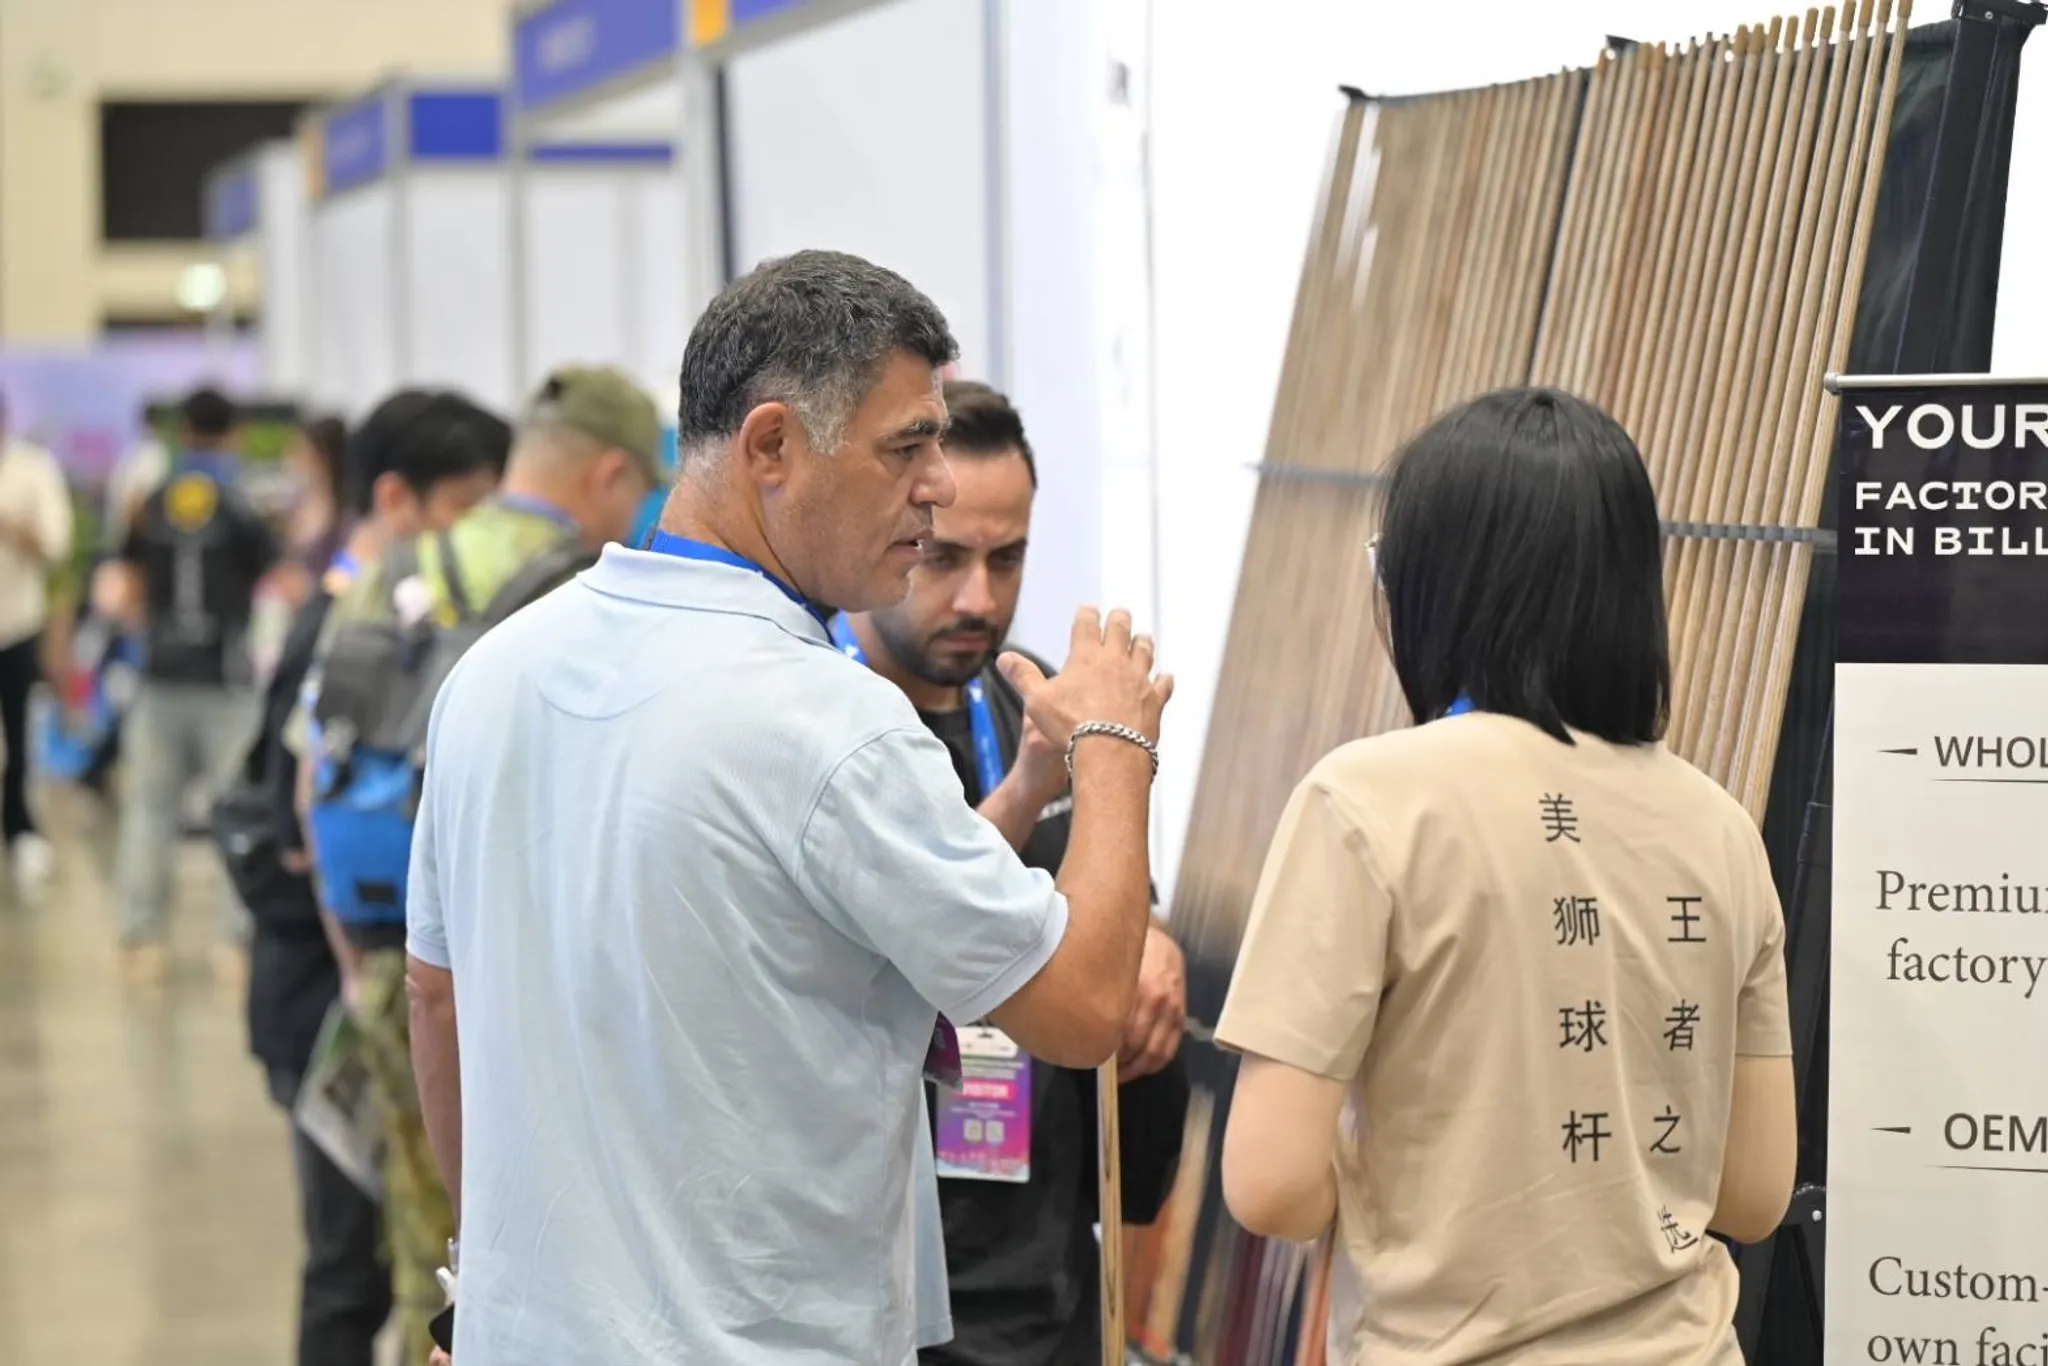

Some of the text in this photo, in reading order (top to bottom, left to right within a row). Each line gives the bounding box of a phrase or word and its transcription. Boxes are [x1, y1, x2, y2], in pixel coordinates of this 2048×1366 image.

[1856, 404, 2048, 450] YOUR
[1856, 481, 2048, 511] FACTOR
[1855, 527, 1914, 556] IN
[1876, 870, 2048, 914] Premiu
[1886, 937, 2048, 994] factory
[1944, 1112, 2048, 1154] OEM
[1867, 1335, 1961, 1366] own
